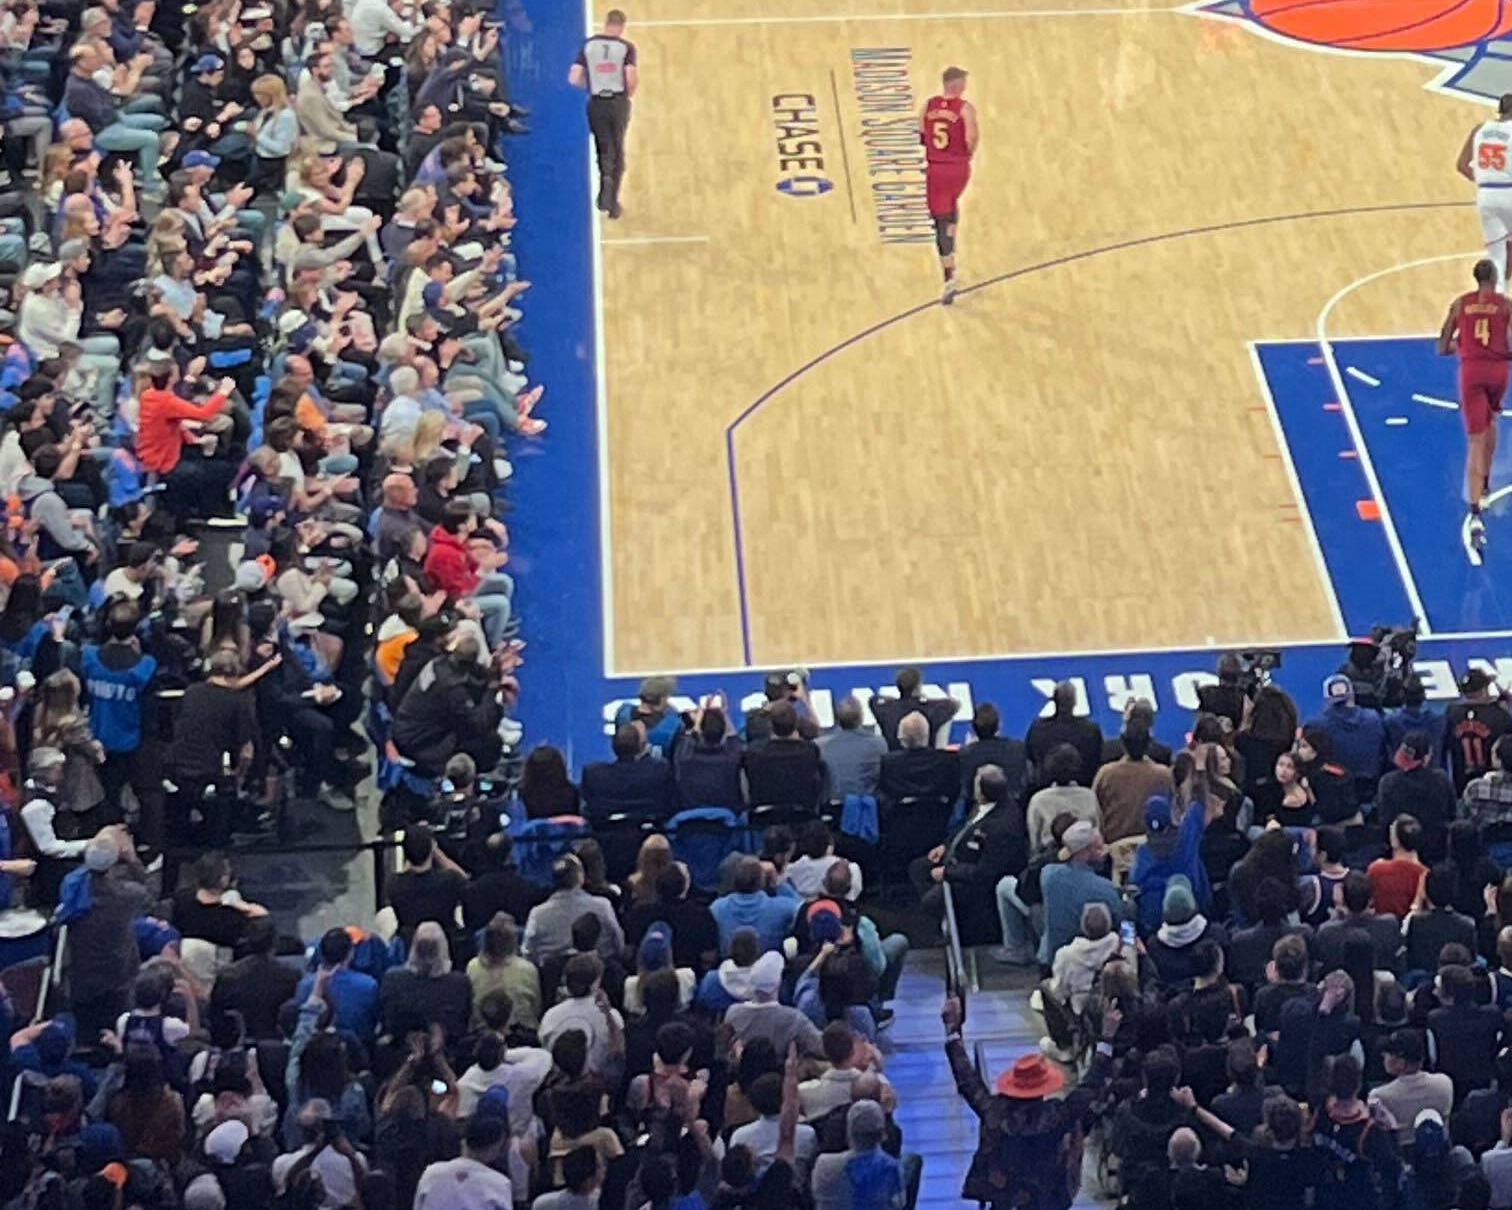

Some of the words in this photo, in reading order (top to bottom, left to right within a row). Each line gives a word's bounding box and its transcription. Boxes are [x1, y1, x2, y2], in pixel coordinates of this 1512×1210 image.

[850, 46, 913, 114] MADISON
[772, 93, 825, 172] CHASE
[857, 116, 926, 178] SQUARE
[932, 121, 950, 150] 5
[1478, 142, 1508, 171] 55
[871, 181, 938, 245] GARDEN
[1474, 317, 1491, 347] 4
